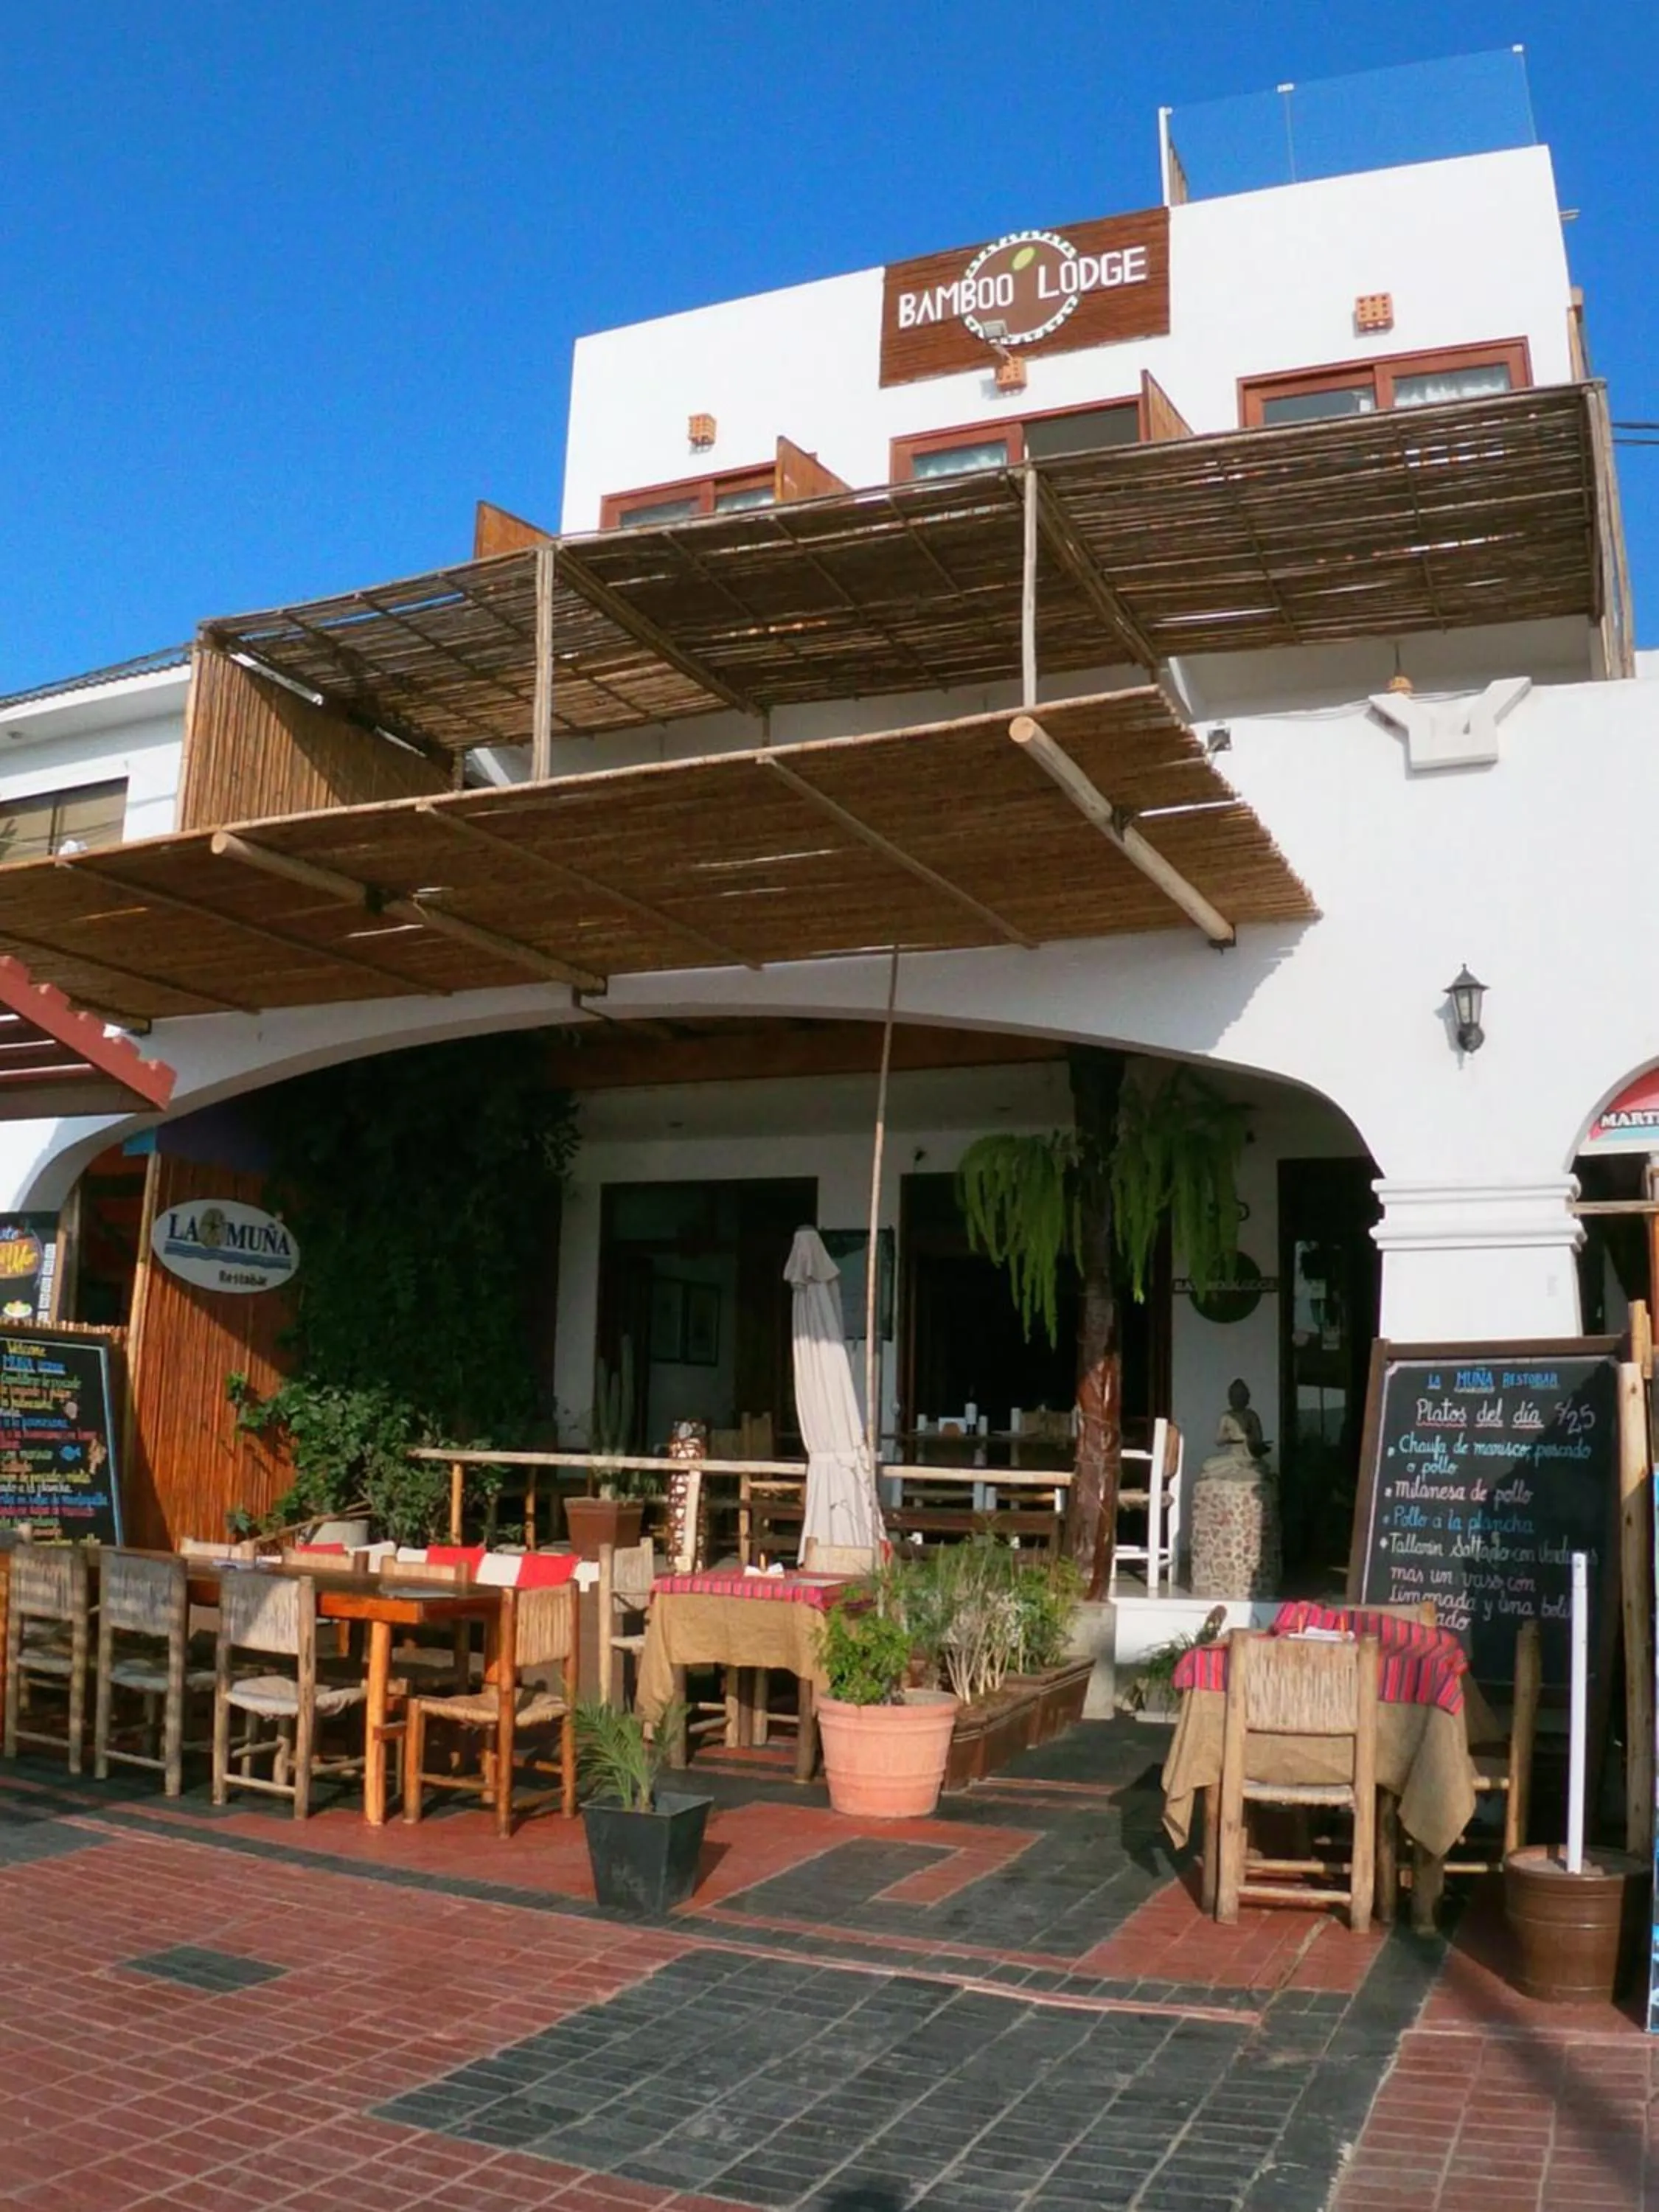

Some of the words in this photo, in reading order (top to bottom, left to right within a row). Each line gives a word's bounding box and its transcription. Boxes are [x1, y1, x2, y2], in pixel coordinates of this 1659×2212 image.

[898, 273, 1015, 330] BAMBOO
[1037, 246, 1147, 300] LODGE
[1600, 1111, 1659, 1128] MART
[168, 1213, 198, 1242] LA
[223, 1222, 291, 1256] MUÑA
[1427, 1373, 1441, 1387] LA
[1456, 1367, 1494, 1388] MUÑA
[1416, 1398, 1467, 1424] Platos
[1476, 1398, 1503, 1424] del
[1513, 1400, 1543, 1425] día
[1399, 1432, 1447, 1460] Chaufa
[1453, 1432, 1468, 1454] de
[1534, 1439, 1593, 1467] pescado
[1406, 1462, 1416, 1474] o
[1421, 1455, 1459, 1481] pollo
[1394, 1475, 1466, 1501] Milanesa
[1470, 1478, 1488, 1503] de
[1493, 1479, 1534, 1512] pollo
[1394, 1505, 1428, 1527] Pollo
[1432, 1515, 1443, 1528] a
[1447, 1509, 1462, 1530] la
[1467, 1509, 1535, 1538] plancha
[1538, 1535, 1599, 1565] Verduas
[1430, 1568, 1453, 1585] un
[1483, 1600, 1495, 1622] y
